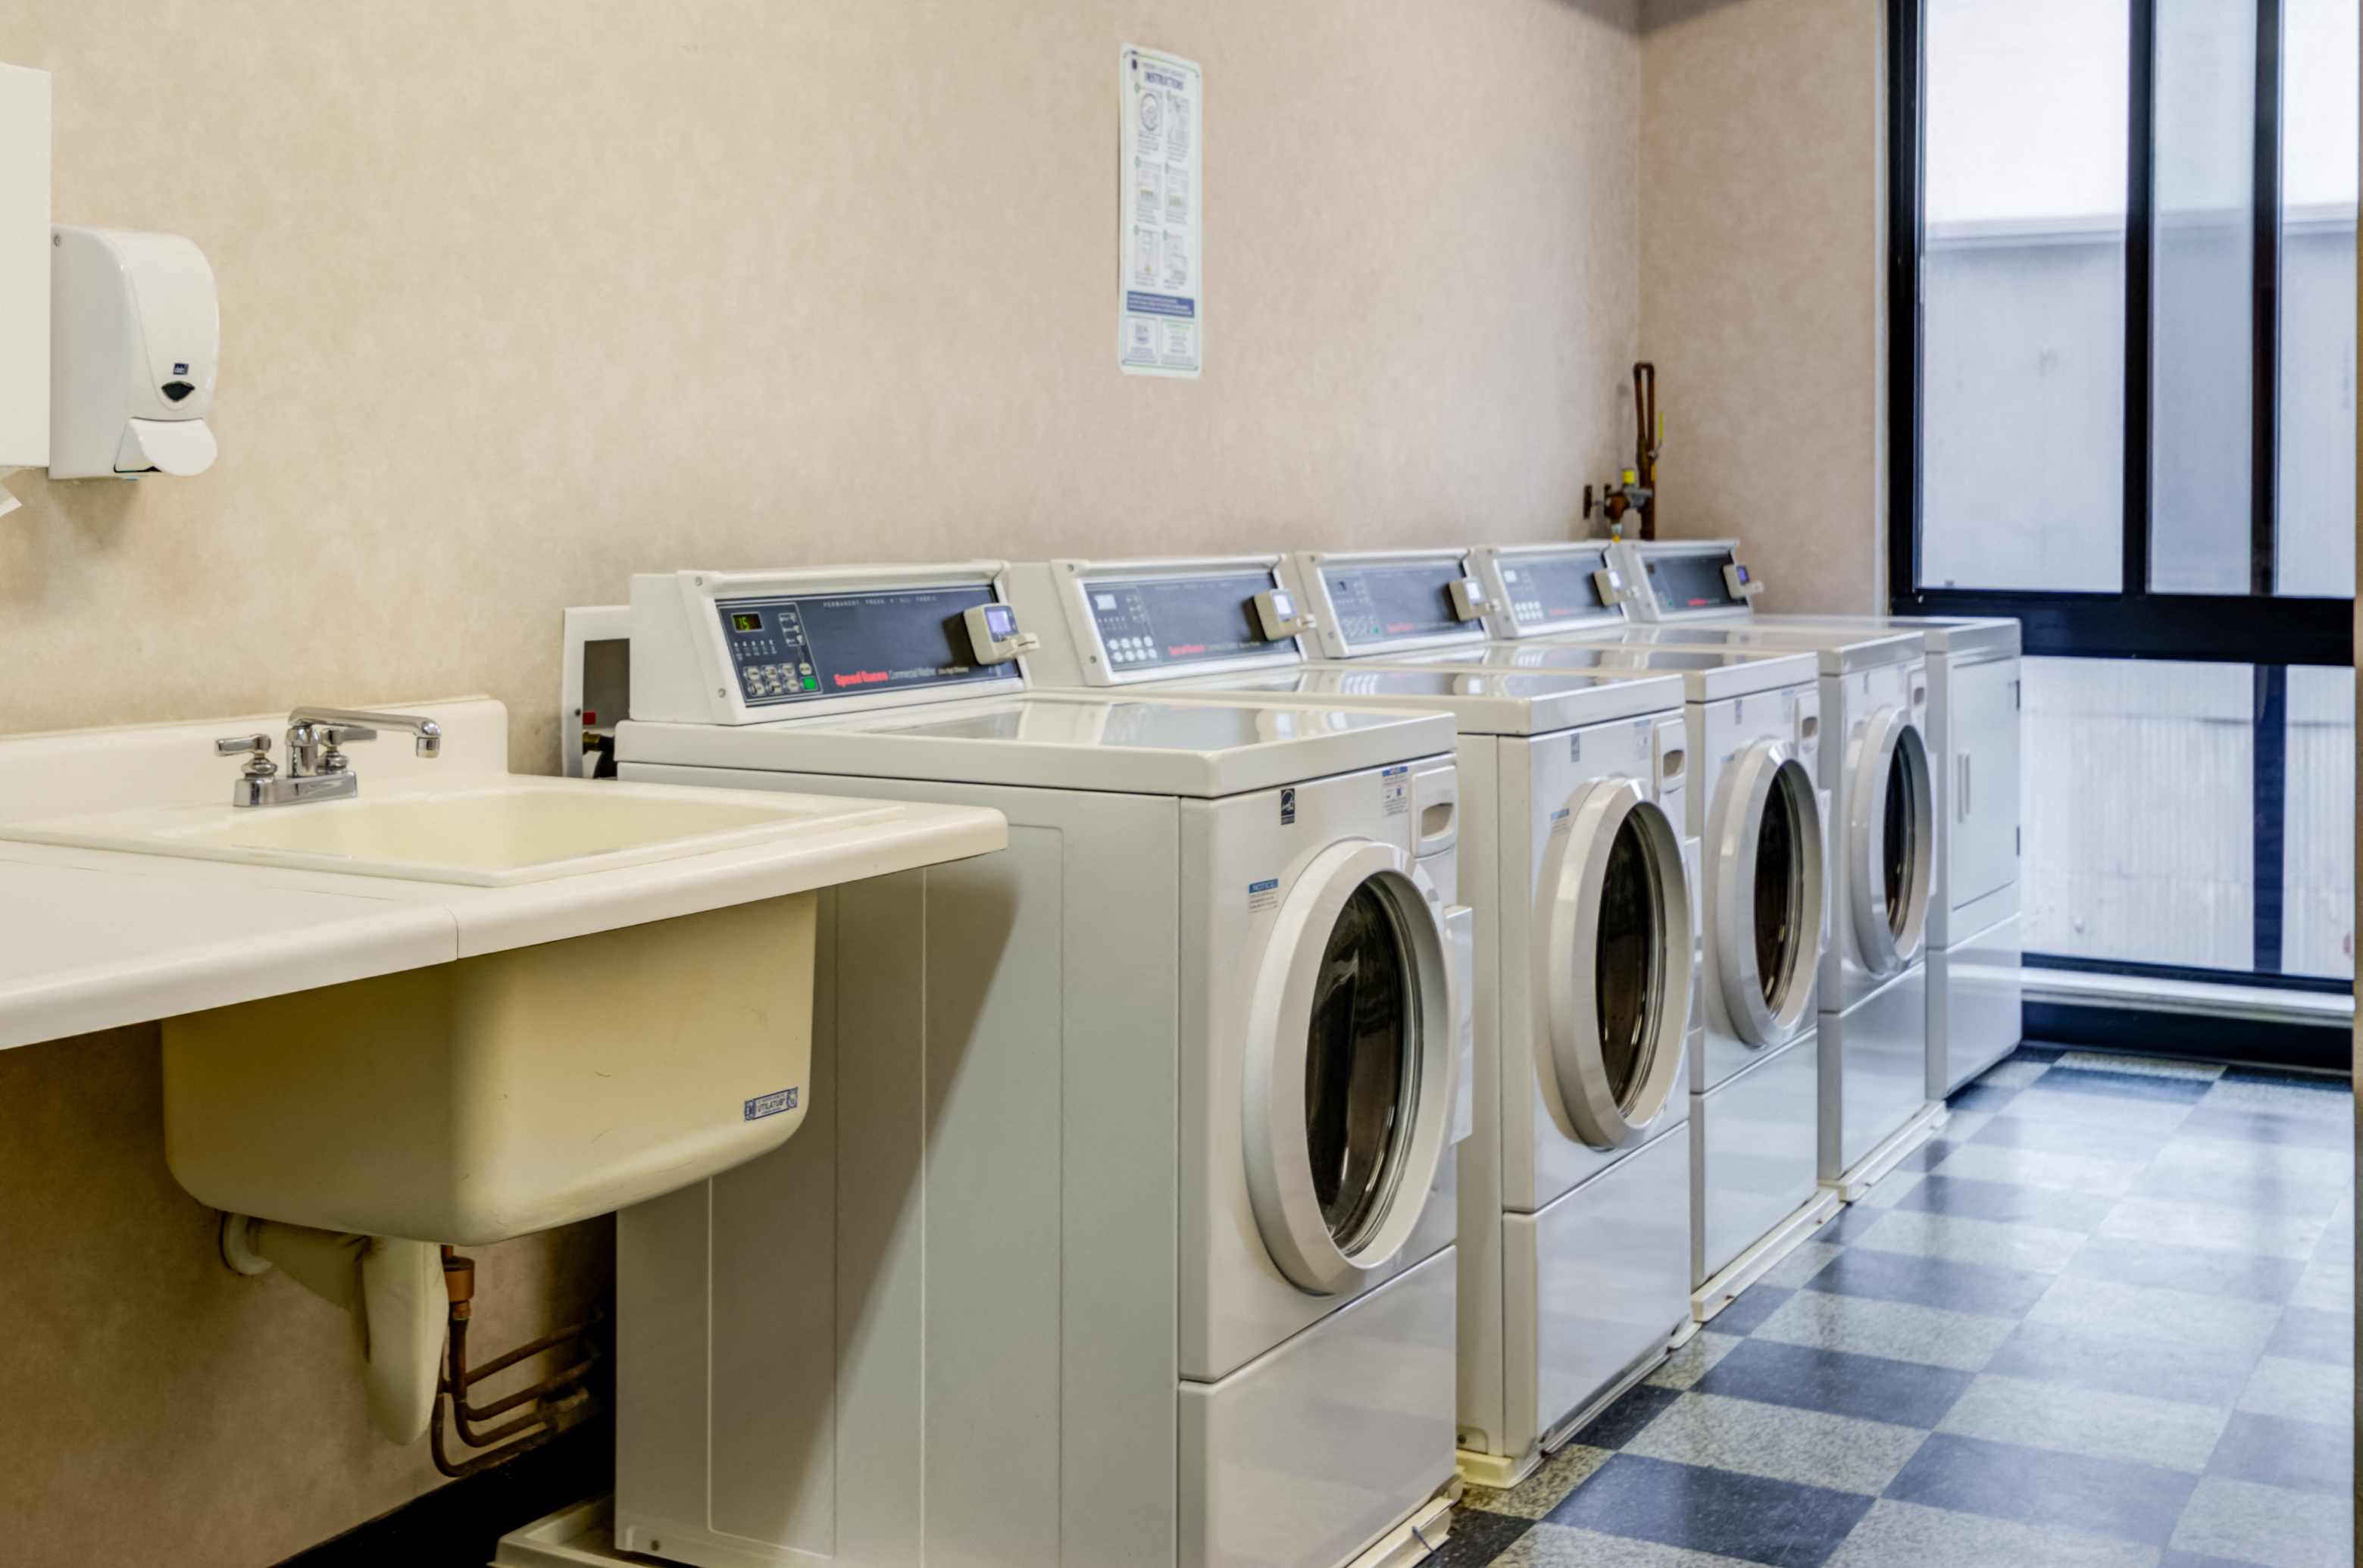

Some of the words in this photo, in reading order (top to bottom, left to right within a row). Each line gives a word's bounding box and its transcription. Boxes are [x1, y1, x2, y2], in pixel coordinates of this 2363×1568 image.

[823, 599, 860, 608] PERMANENT
[833, 670, 863, 688] Speed
[861, 670, 889, 683] Queen
[1252, 879, 1276, 892] NOTICE
